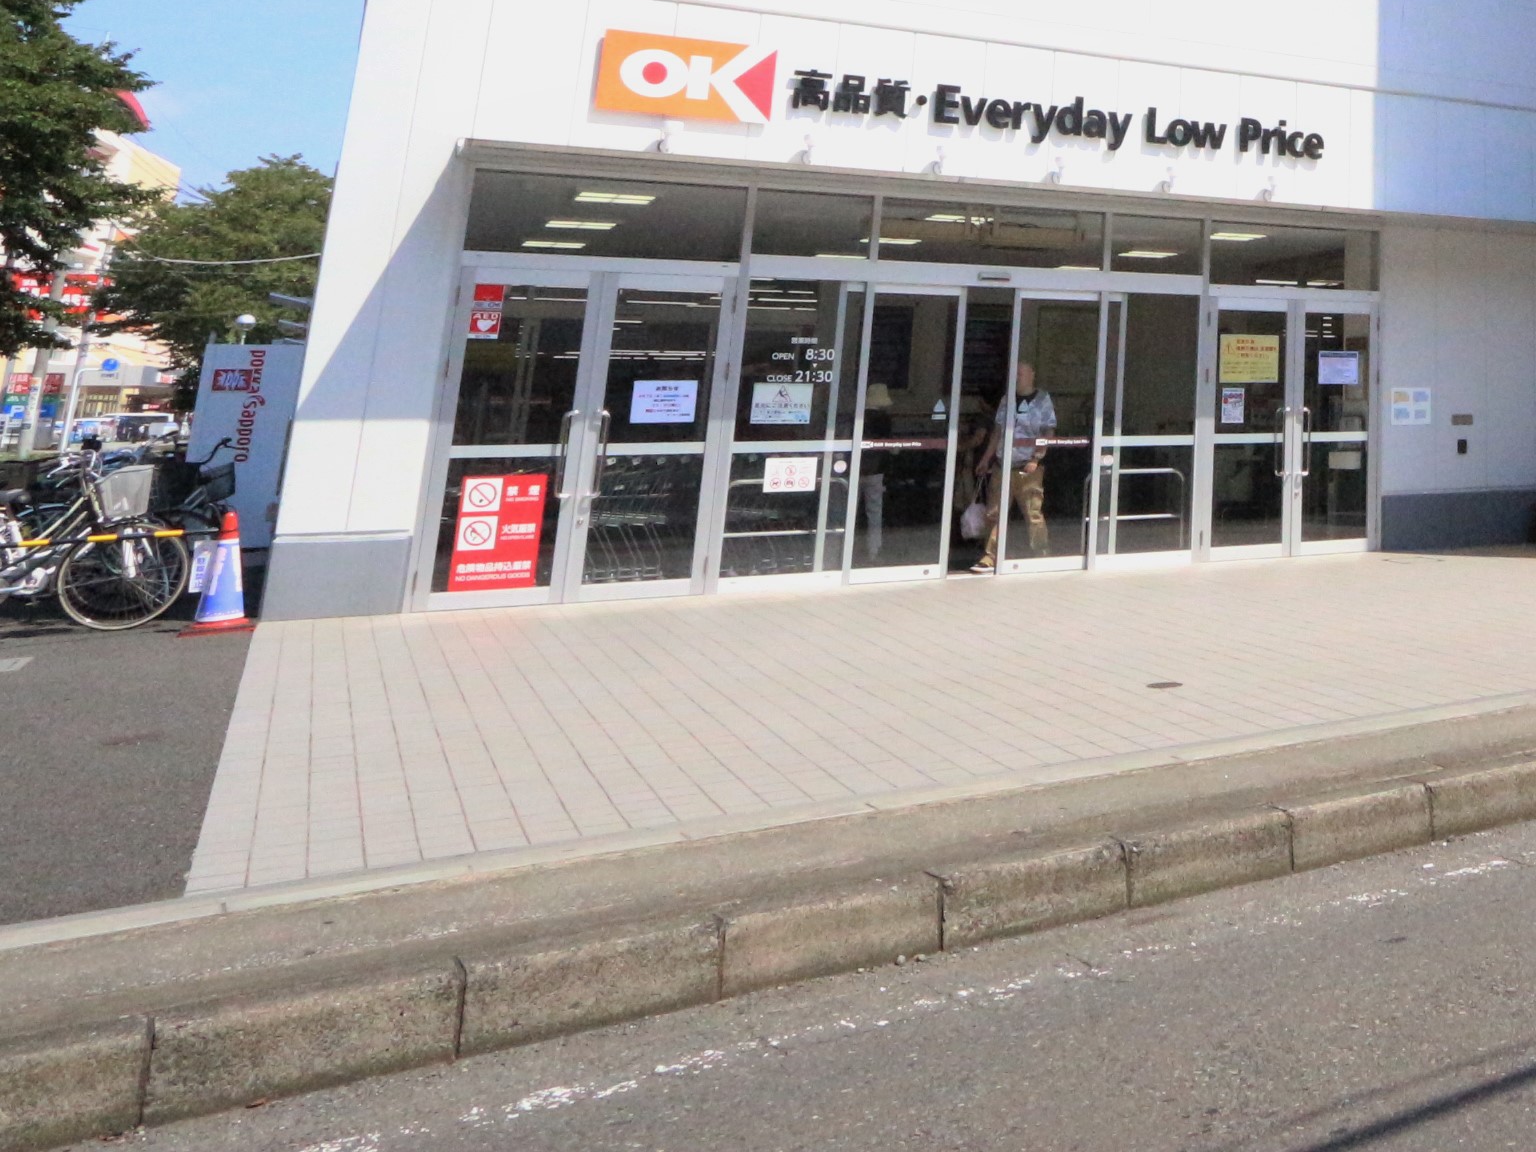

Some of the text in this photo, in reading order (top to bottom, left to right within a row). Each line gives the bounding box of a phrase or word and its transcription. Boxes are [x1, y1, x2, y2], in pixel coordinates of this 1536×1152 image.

[617, 45, 778, 124] OK
[933, 83, 1133, 152] Everyday
[1145, 106, 1227, 151] Low
[1239, 116, 1325, 161] Price
[472, 312, 499, 320] AED
[771, 348, 836, 361] OPEN 8:30
[766, 370, 833, 383] CLOSE 21:30
